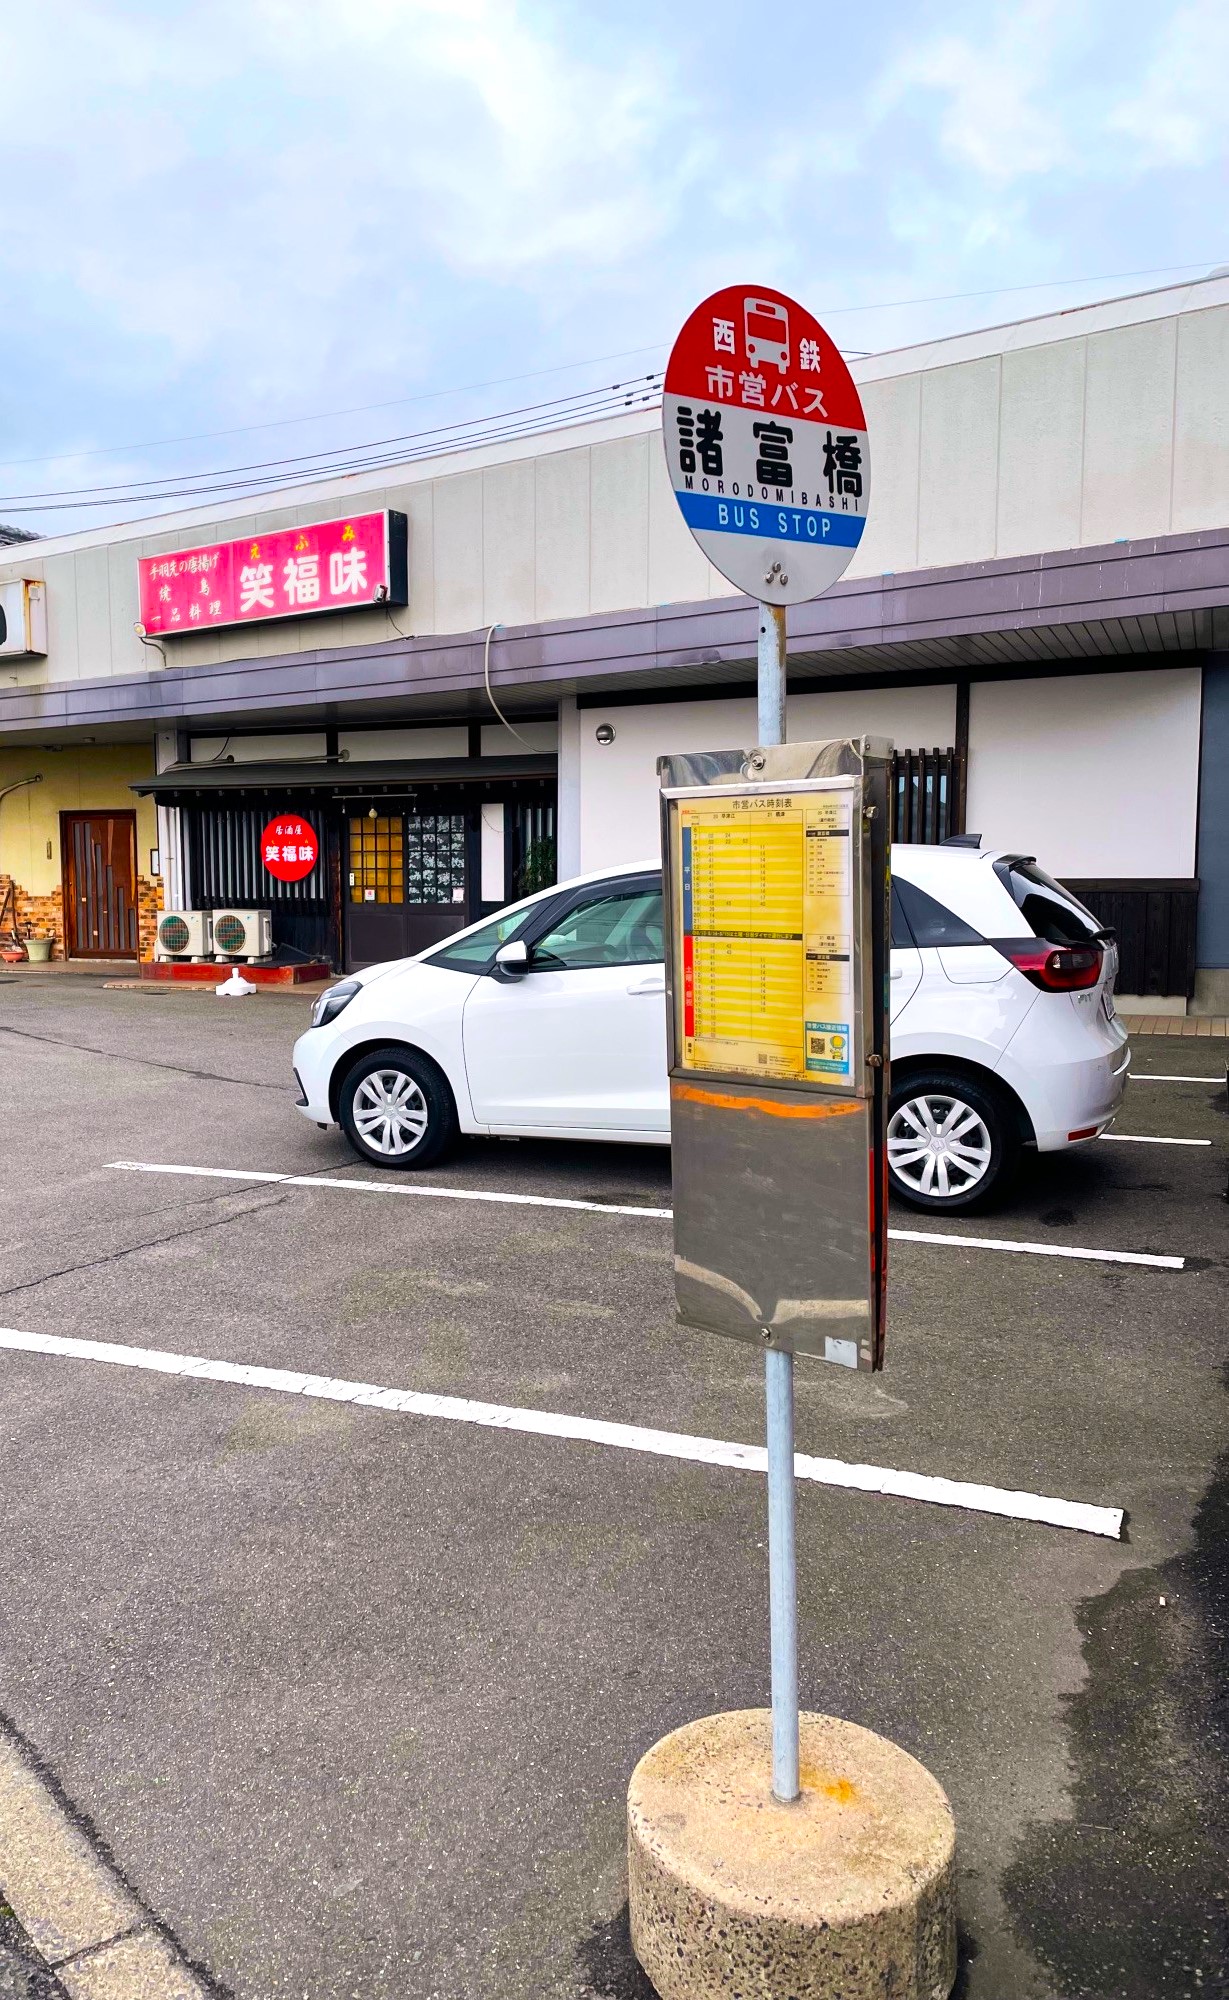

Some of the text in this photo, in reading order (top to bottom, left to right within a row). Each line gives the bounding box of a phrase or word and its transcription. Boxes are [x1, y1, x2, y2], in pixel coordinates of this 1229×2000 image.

[712, 318, 822, 374] 西 鉄
[705, 365, 829, 418] 市営バス
[676, 405, 863, 498] 諸富橋
[685, 475, 859, 511] MORODOMIBASHI
[718, 503, 831, 538] BUS STOP
[251, 534, 356, 560] えふみ
[149, 551, 219, 581] 手羽先の唐揚げ
[239, 546, 368, 613] 笑福味
[151, 600, 222, 622] 一品料理
[732, 798, 793, 810] 市営バス時刻表
[275, 824, 302, 836] 居酒屋
[265, 845, 314, 862] 笑福味
